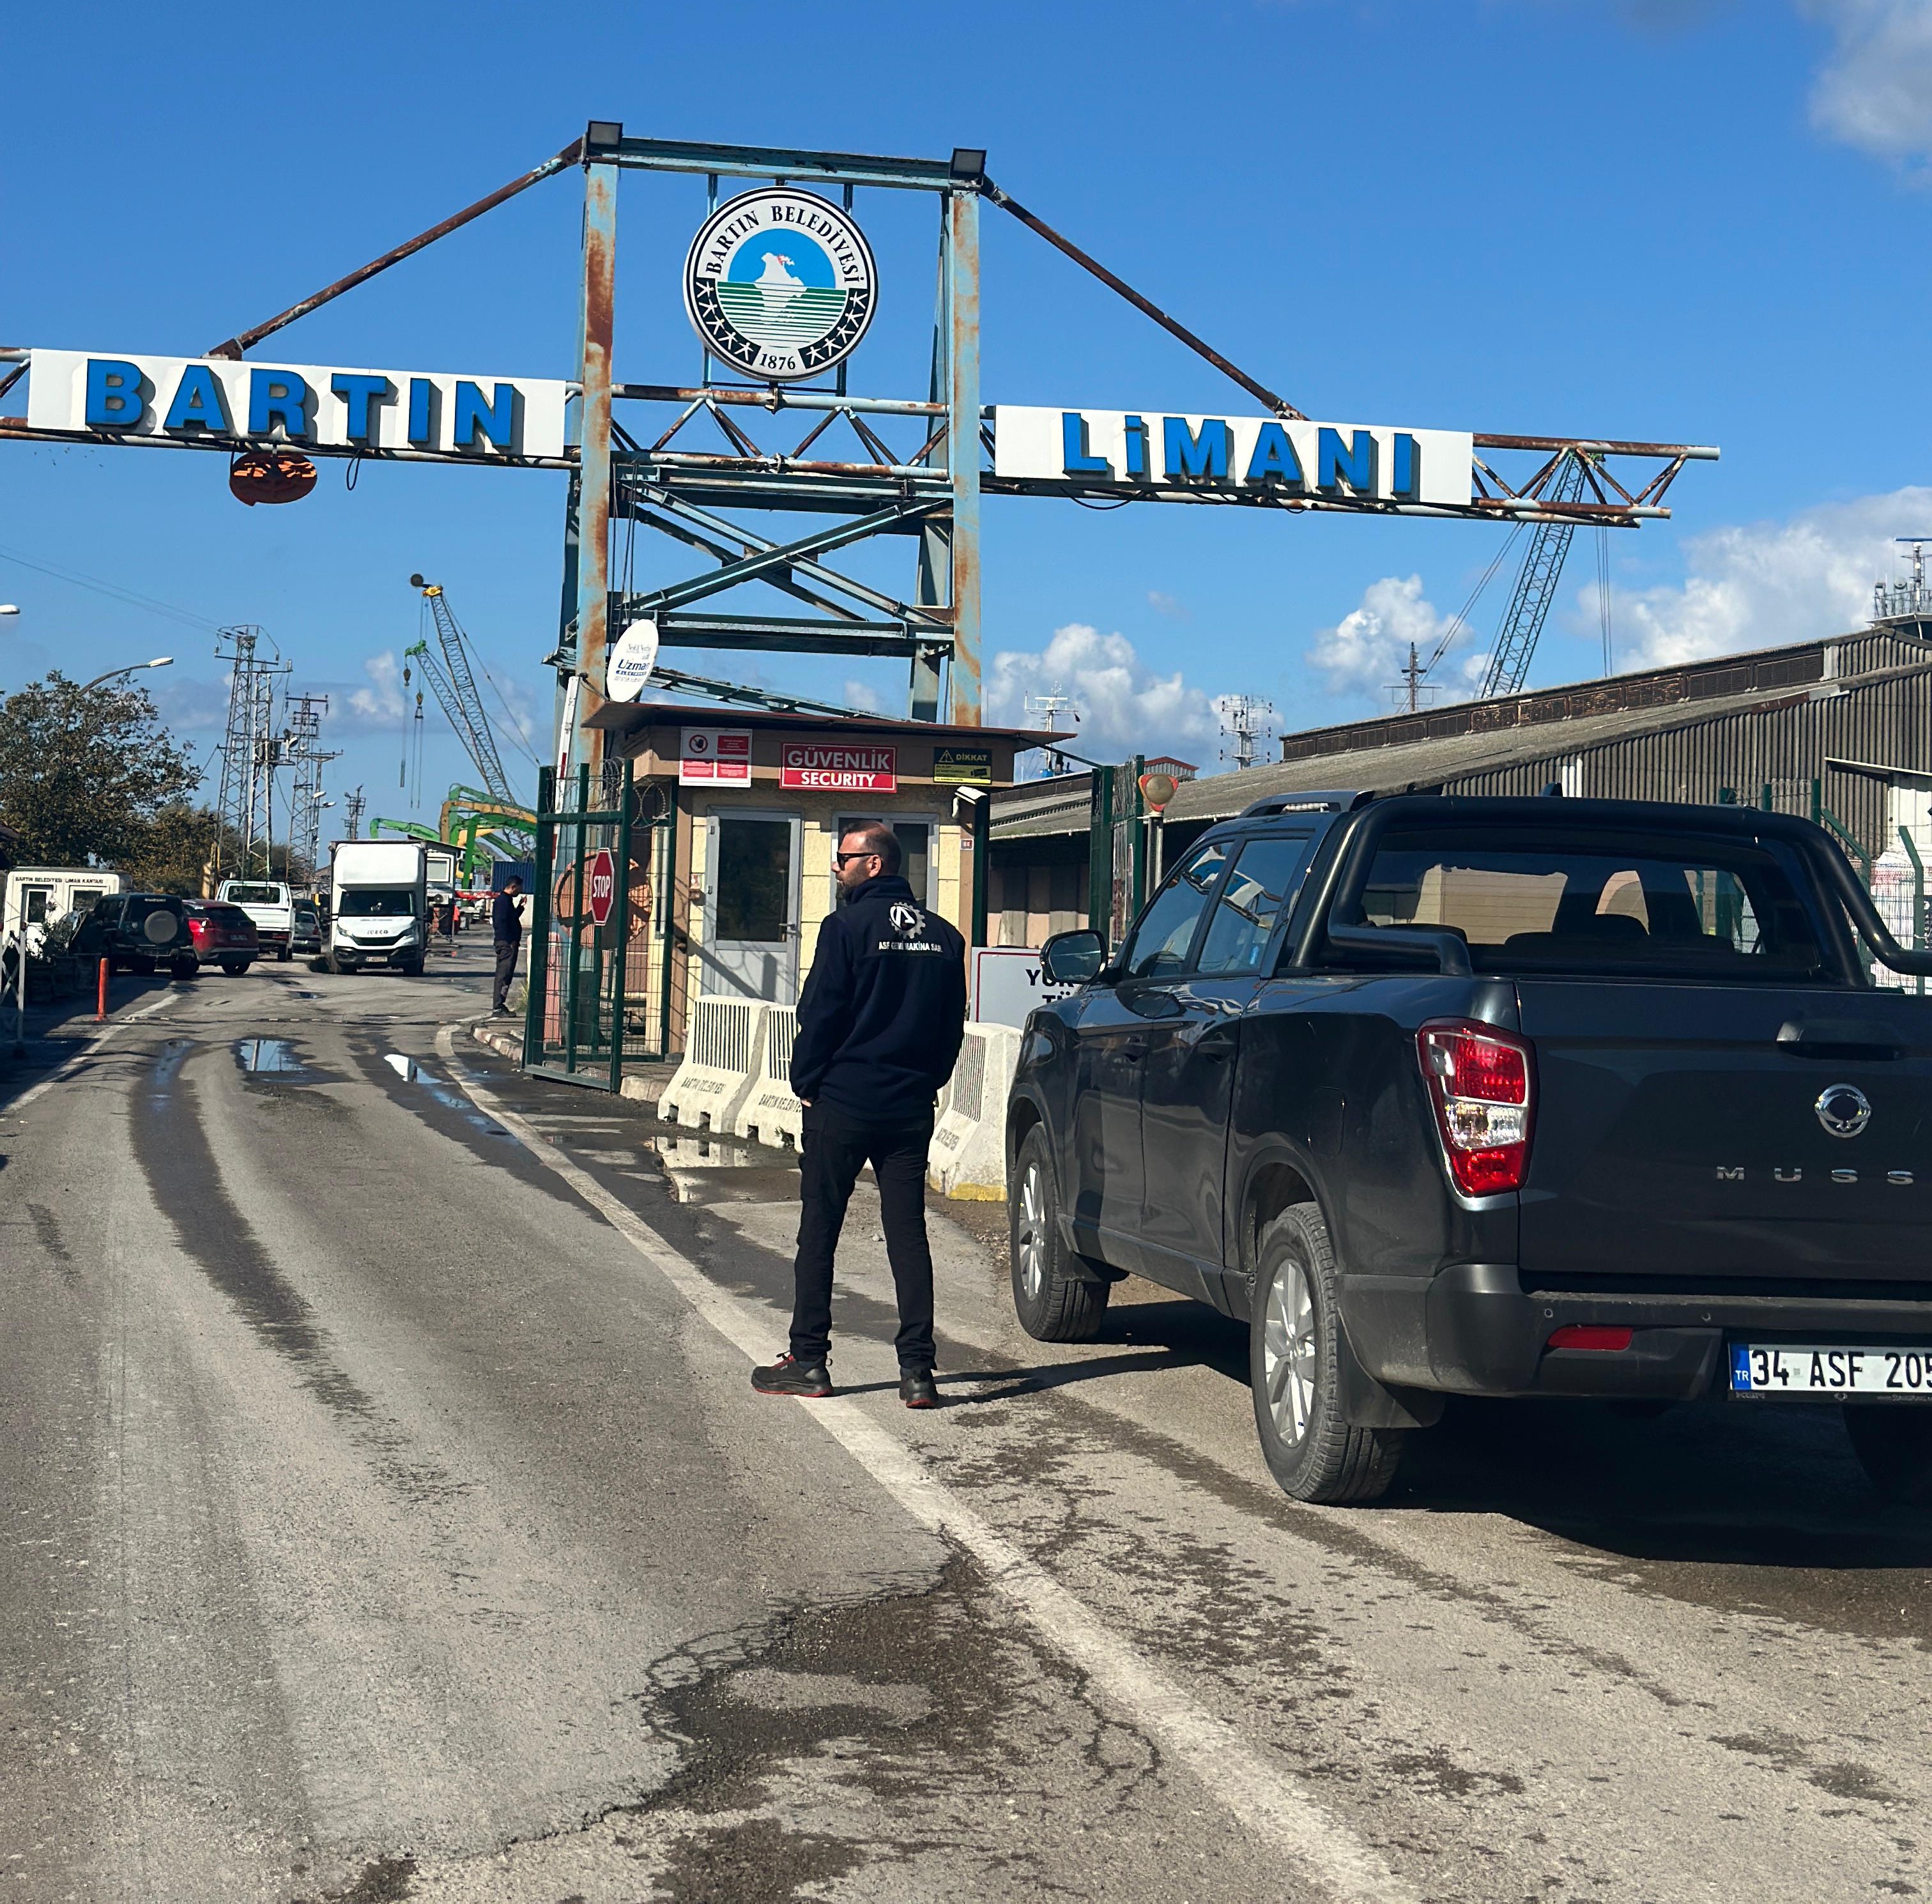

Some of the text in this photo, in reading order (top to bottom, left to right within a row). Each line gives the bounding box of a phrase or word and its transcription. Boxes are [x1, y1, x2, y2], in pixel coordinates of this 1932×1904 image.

[706, 205, 864, 282] BARTIN BELEDİYESİ
[759, 353, 796, 370] 1876
[86, 358, 516, 447] BARTIN
[787, 746, 890, 770] GÜVENLİK
[956, 752, 988, 762] DİKKAT
[801, 771, 876, 787] SECURITY
[593, 875, 611, 898] STOP
[878, 941, 890, 949] ASF
[1717, 1166, 1914, 1185] MUSS
[1735, 1370, 1749, 1381] TR
[1751, 1349, 1789, 1386] 34
[1809, 1351, 1865, 1387] ASF
